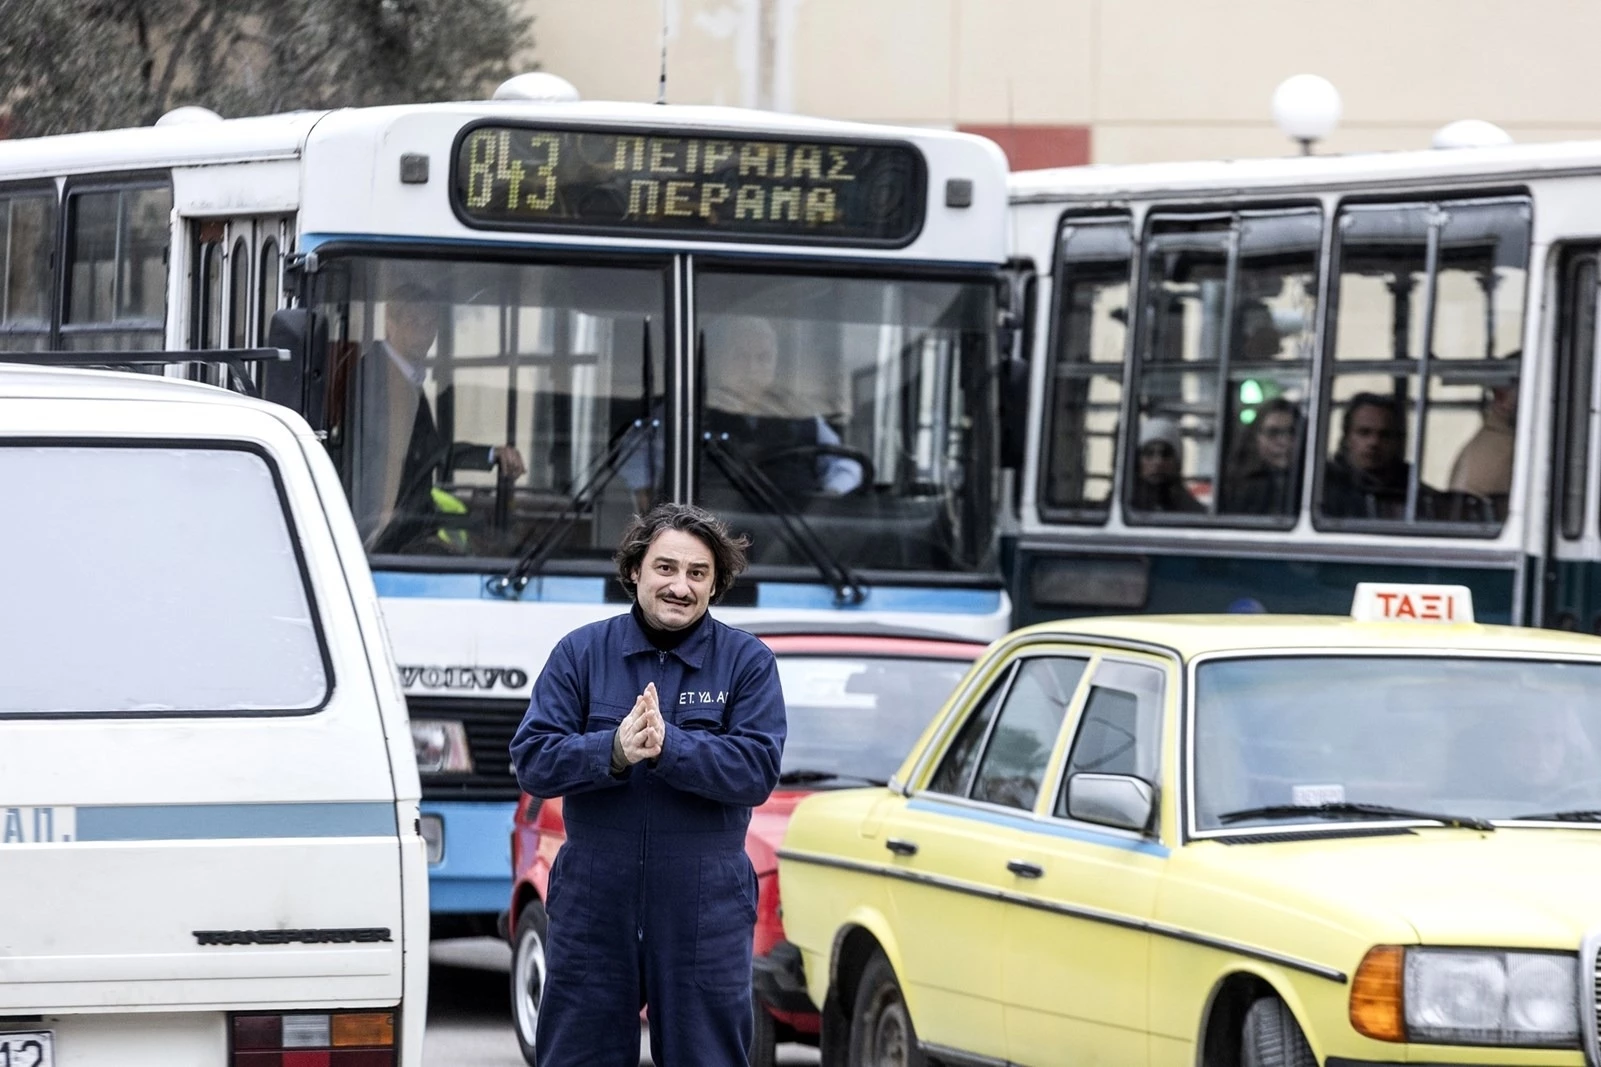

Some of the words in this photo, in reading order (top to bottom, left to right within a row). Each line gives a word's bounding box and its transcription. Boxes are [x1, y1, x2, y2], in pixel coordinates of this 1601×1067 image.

[612, 134, 856, 181] ΠΕΙΡΑΙΑΣ
[628, 179, 837, 223] ΠΕΡΑΜΑ
[1376, 593, 1454, 620] ΤΑΞΙ
[398, 666, 529, 689] VOLVO
[679, 691, 695, 704] ΕΤ.
[698, 691, 714, 703] ΥΔ.
[192, 927, 394, 946] TRANSPORTER
